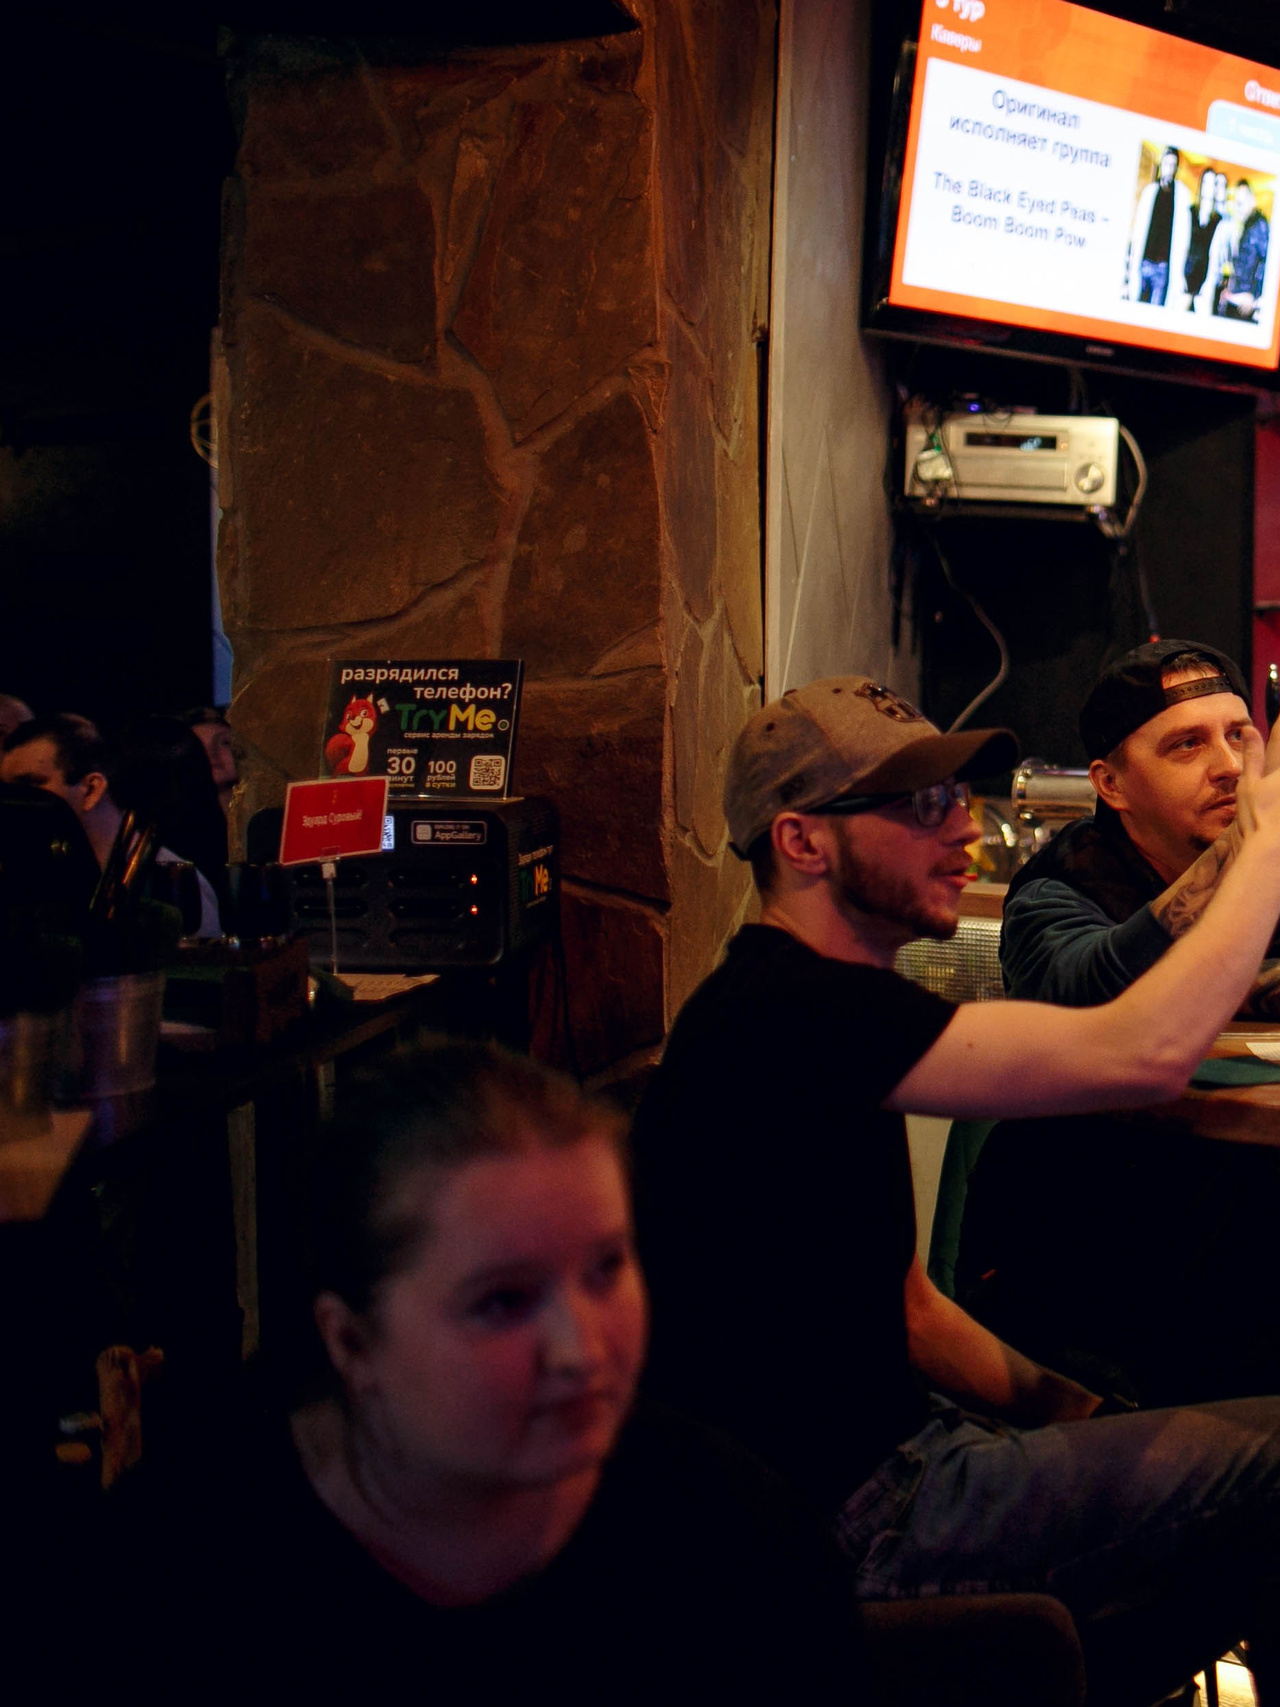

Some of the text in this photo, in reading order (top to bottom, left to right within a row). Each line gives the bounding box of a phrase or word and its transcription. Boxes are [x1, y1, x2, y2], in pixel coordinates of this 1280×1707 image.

[992, 89, 1080, 129] Оригинал
[949, 115, 1111, 168] исполняет группа
[935, 171, 962, 194] The
[968, 180, 1010, 204] Black
[1017, 191, 1056, 214] Eyed
[1061, 201, 1096, 223] Peas
[951, 204, 1086, 248] Boom Boom Pow
[341, 668, 459, 684] разрядился
[414, 683, 512, 702] телефон?
[387, 756, 416, 774] 30
[428, 761, 456, 773] 100
[434, 831, 482, 841] AppGallery
